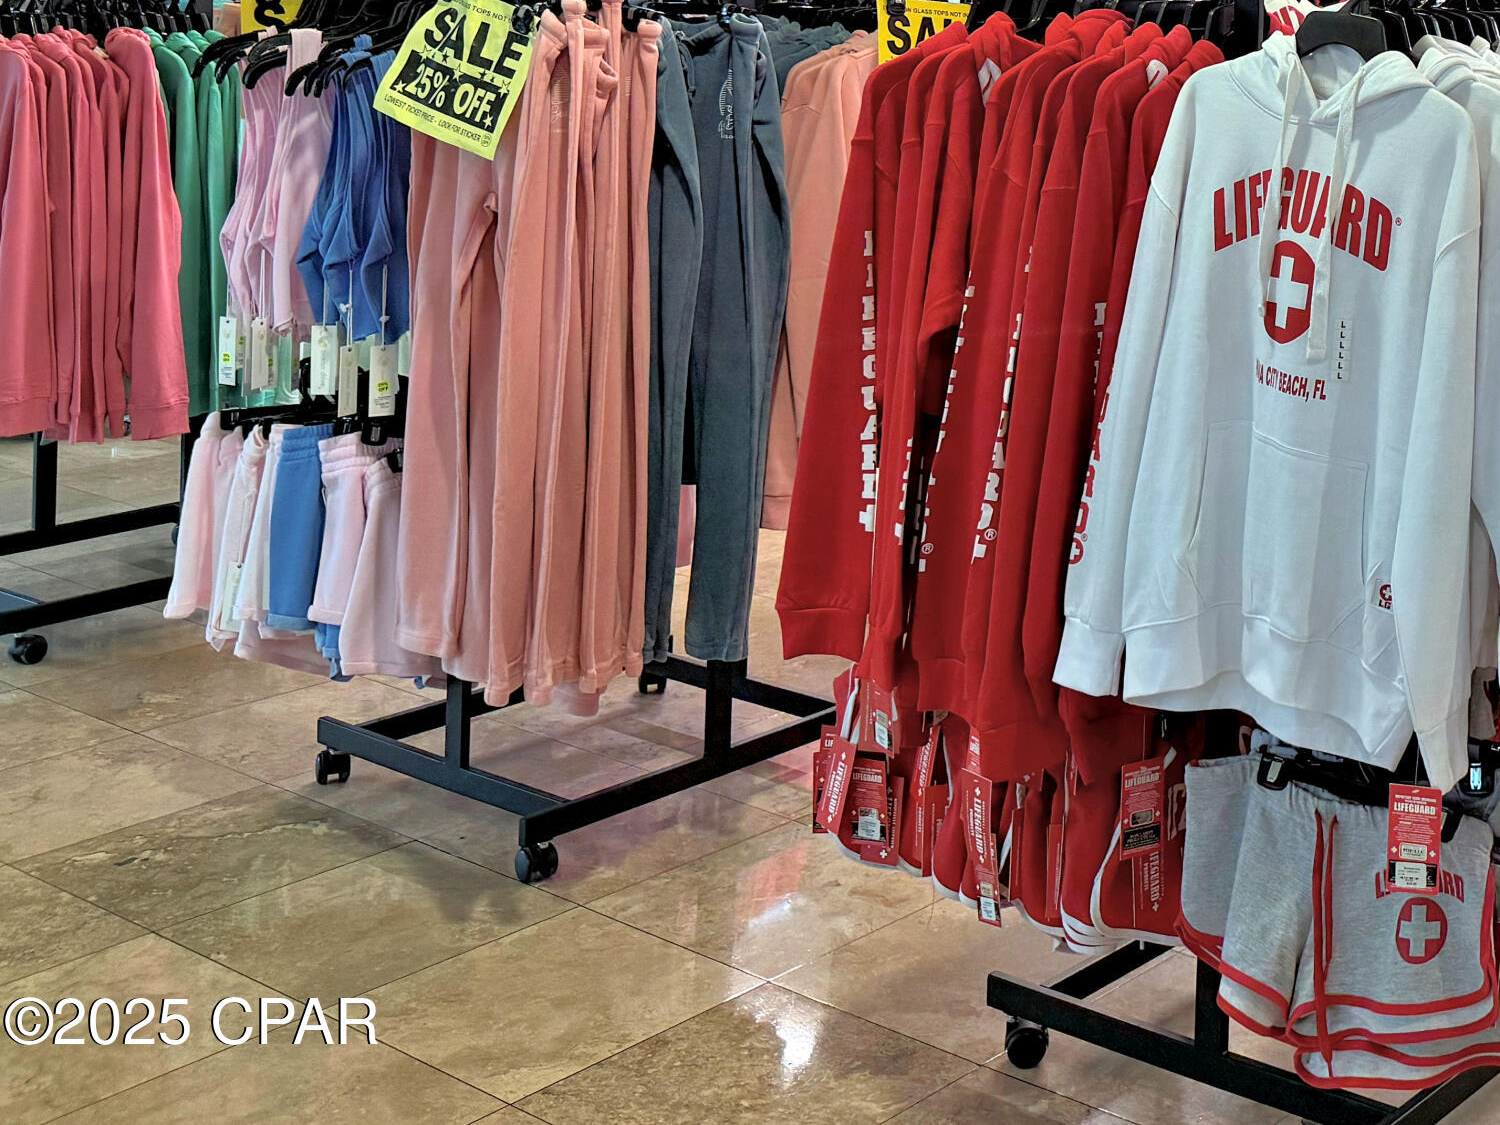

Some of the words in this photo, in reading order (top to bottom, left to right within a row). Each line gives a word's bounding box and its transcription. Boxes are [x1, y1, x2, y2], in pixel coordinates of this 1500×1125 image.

[473, 5, 491, 17] TOPS
[492, 12, 508, 22] NOT
[913, 7, 932, 15] GLASS
[424, 8, 530, 80] SALE
[404, 63, 450, 108] 25%
[453, 83, 496, 123] OFF
[384, 93, 407, 108] LOWEST
[420, 111, 435, 123] PRICE
[451, 124, 461, 134] FOR
[460, 127, 480, 142] STICKER
[1313, 379, 1326, 401] FL
[828, 761, 845, 814] LIFEGUARD
[1125, 772, 1160, 788] LIFEGUARD
[974, 797, 984, 853] LIFEGUARD
[1393, 801, 1436, 815] LIFEGUARD
